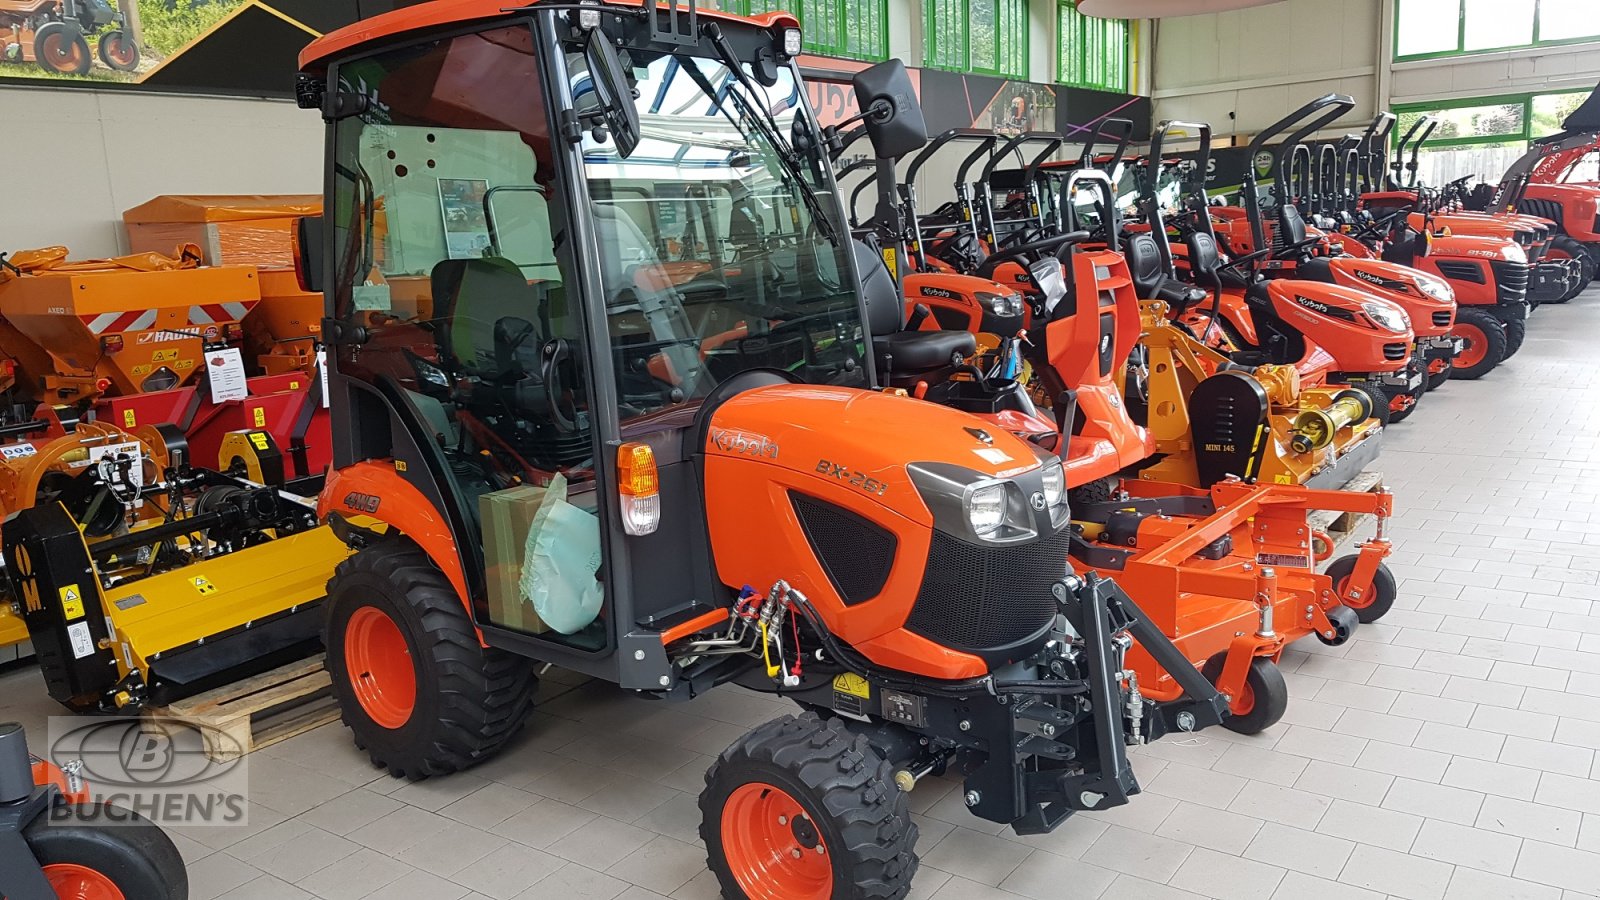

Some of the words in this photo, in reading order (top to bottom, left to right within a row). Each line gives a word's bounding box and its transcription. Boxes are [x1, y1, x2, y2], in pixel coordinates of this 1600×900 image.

[1535, 153, 1562, 178] Kubota
[1357, 271, 1384, 285] Kubota
[923, 287, 950, 298] Kubota
[1299, 297, 1328, 313] Kubota
[711, 428, 779, 458] Kubota
[815, 459, 889, 496] BX-261
[344, 492, 381, 513] 4WD
